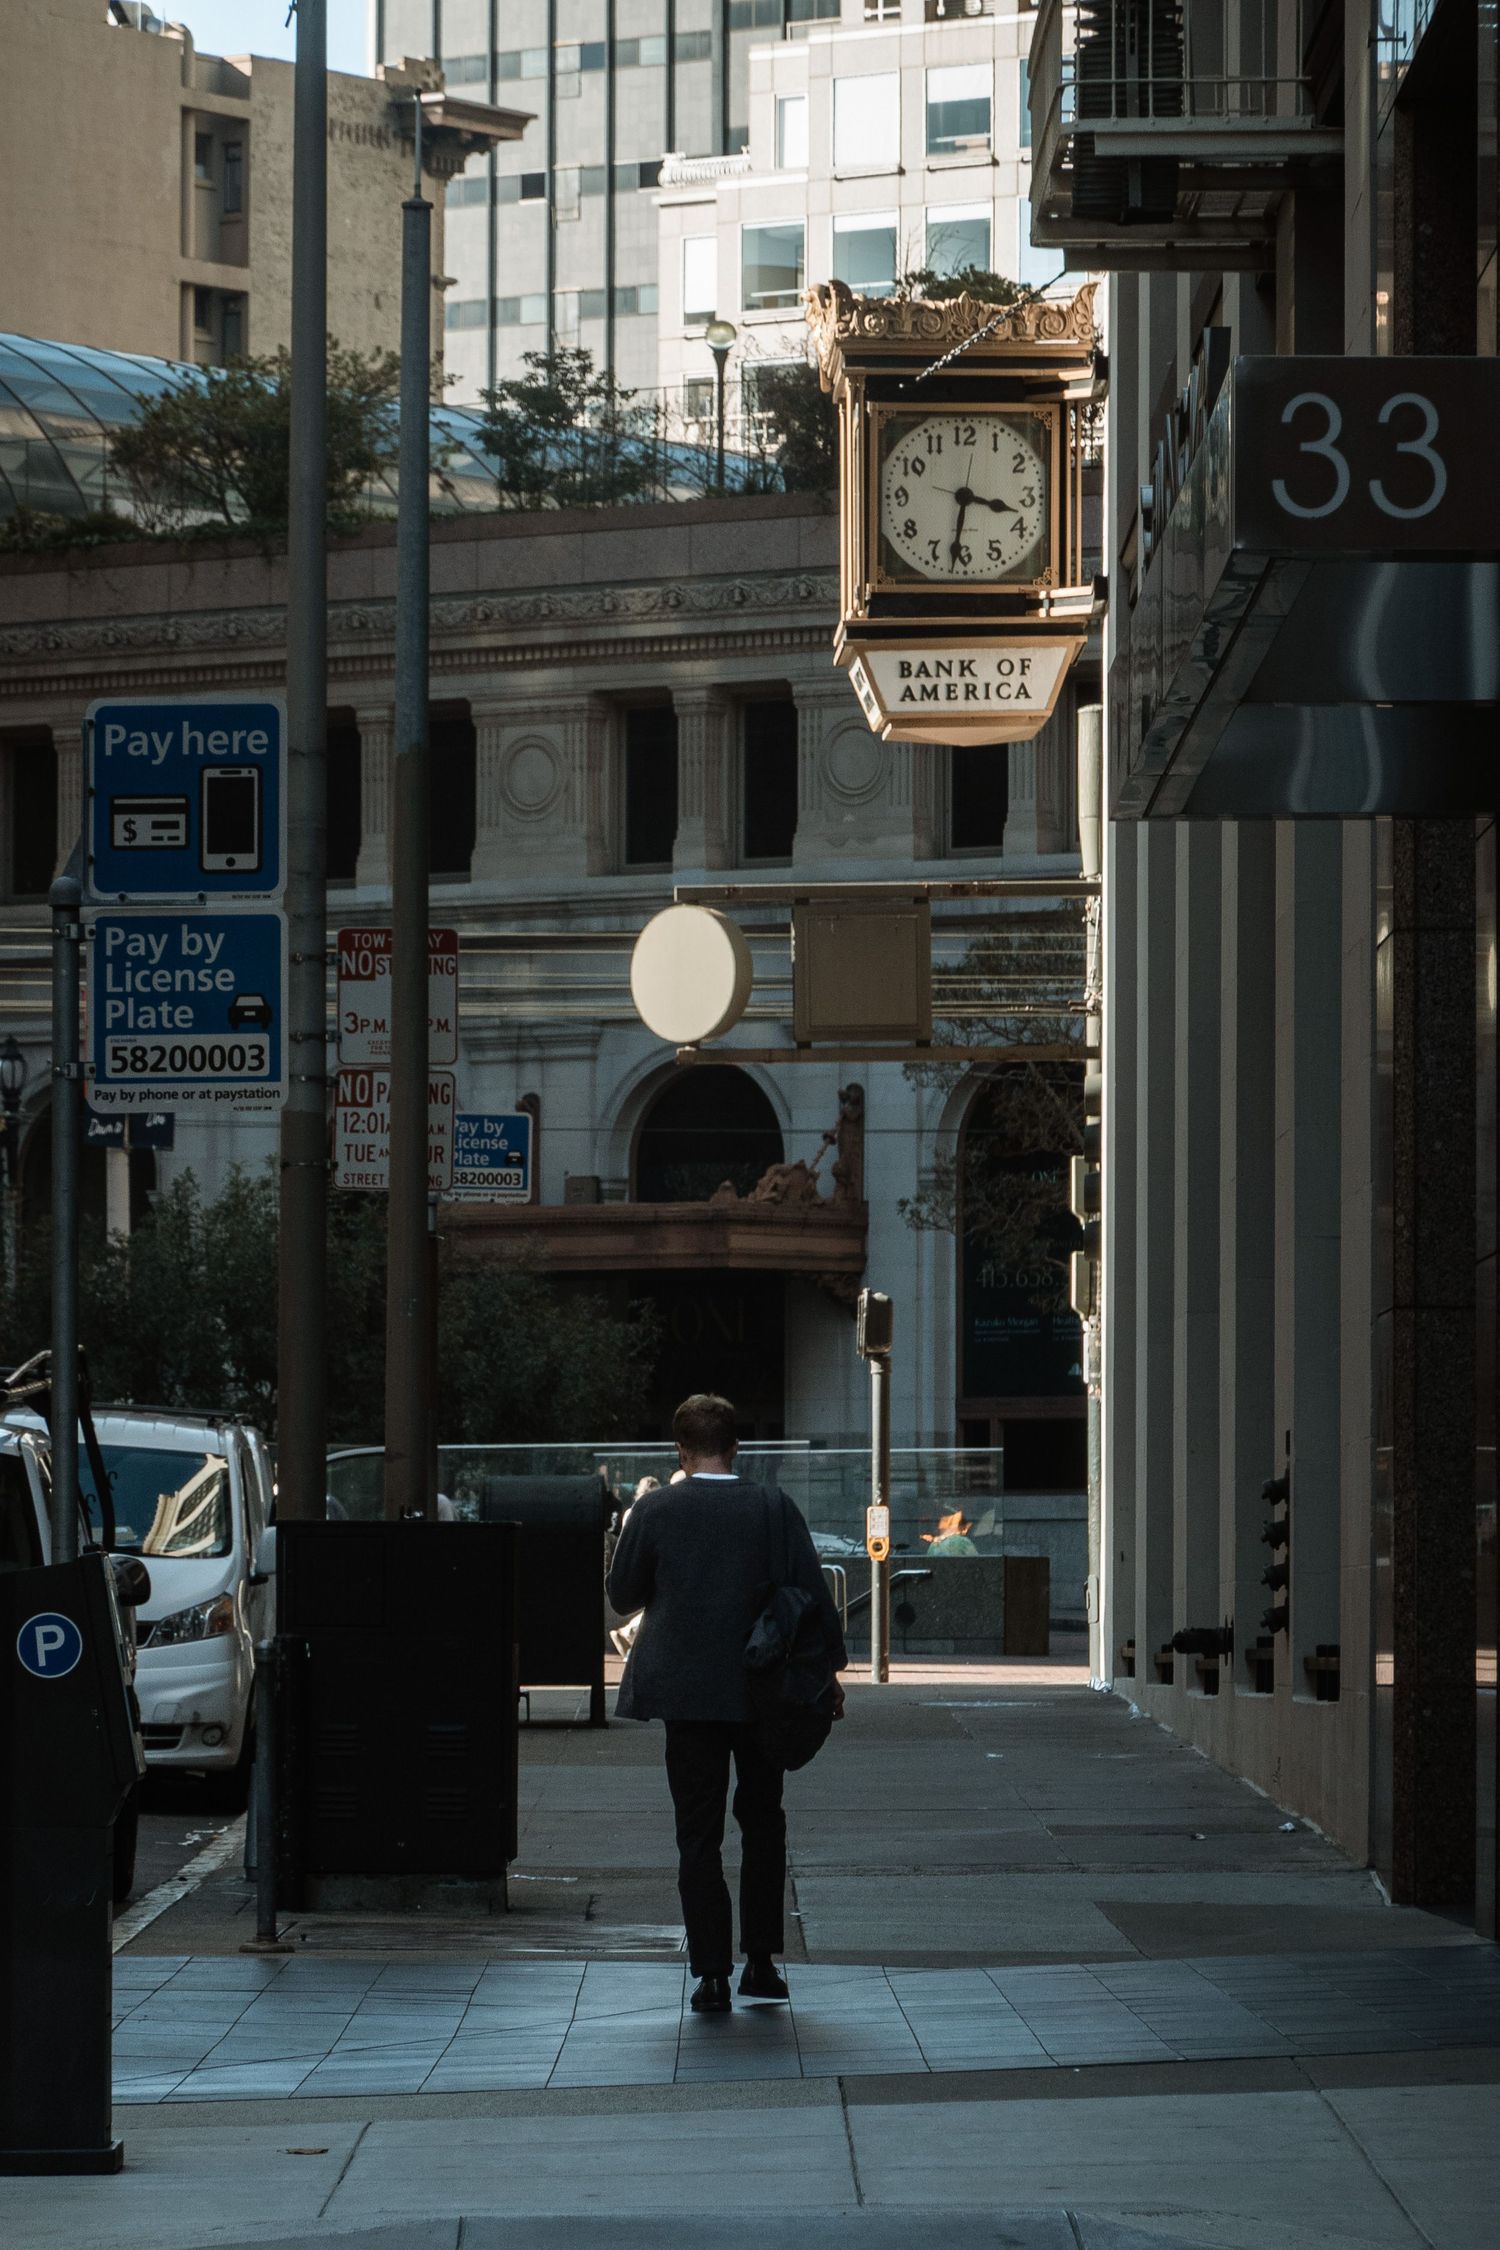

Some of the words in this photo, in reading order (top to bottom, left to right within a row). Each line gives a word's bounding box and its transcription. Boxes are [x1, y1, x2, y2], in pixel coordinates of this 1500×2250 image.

[927, 434, 942, 455] 11
[954, 425, 976, 446] 12
[992, 432, 999, 453] 1
[903, 455, 926, 477] 10
[1012, 453, 1026, 473] 2
[1272, 392, 1447, 519] 33
[894, 486, 909, 507] 9
[1019, 486, 1036, 508] 3
[904, 518, 918, 539] 8
[1010, 516, 1027, 539] 4
[928, 540, 941, 562] 7
[957, 546, 972, 567] 6
[987, 540, 1002, 561] 5
[899, 659, 977, 678] BANK
[997, 658, 1032, 676] OF
[899, 682, 1032, 702] AMERICA
[104, 724, 173, 766] Pay
[181, 721, 269, 756] here
[105, 926, 168, 965] Pay
[180, 923, 225, 964] by
[341, 950, 373, 976] NO
[105, 962, 235, 993] License
[105, 997, 194, 1029] Plate
[111, 1044, 265, 1073] 58200003
[94, 1090, 117, 1103] Pay
[120, 1088, 135, 1102] by
[139, 1088, 179, 1102] phone
[182, 1089, 196, 1099] or
[199, 1088, 212, 1099] at
[214, 1087, 281, 1101] paystation
[338, 1074, 370, 1104] NO
[484, 1118, 504, 1137] by
[344, 1144, 376, 1162] TUE
[344, 1173, 384, 1185] STREET
[35, 1624, 65, 1667] P
